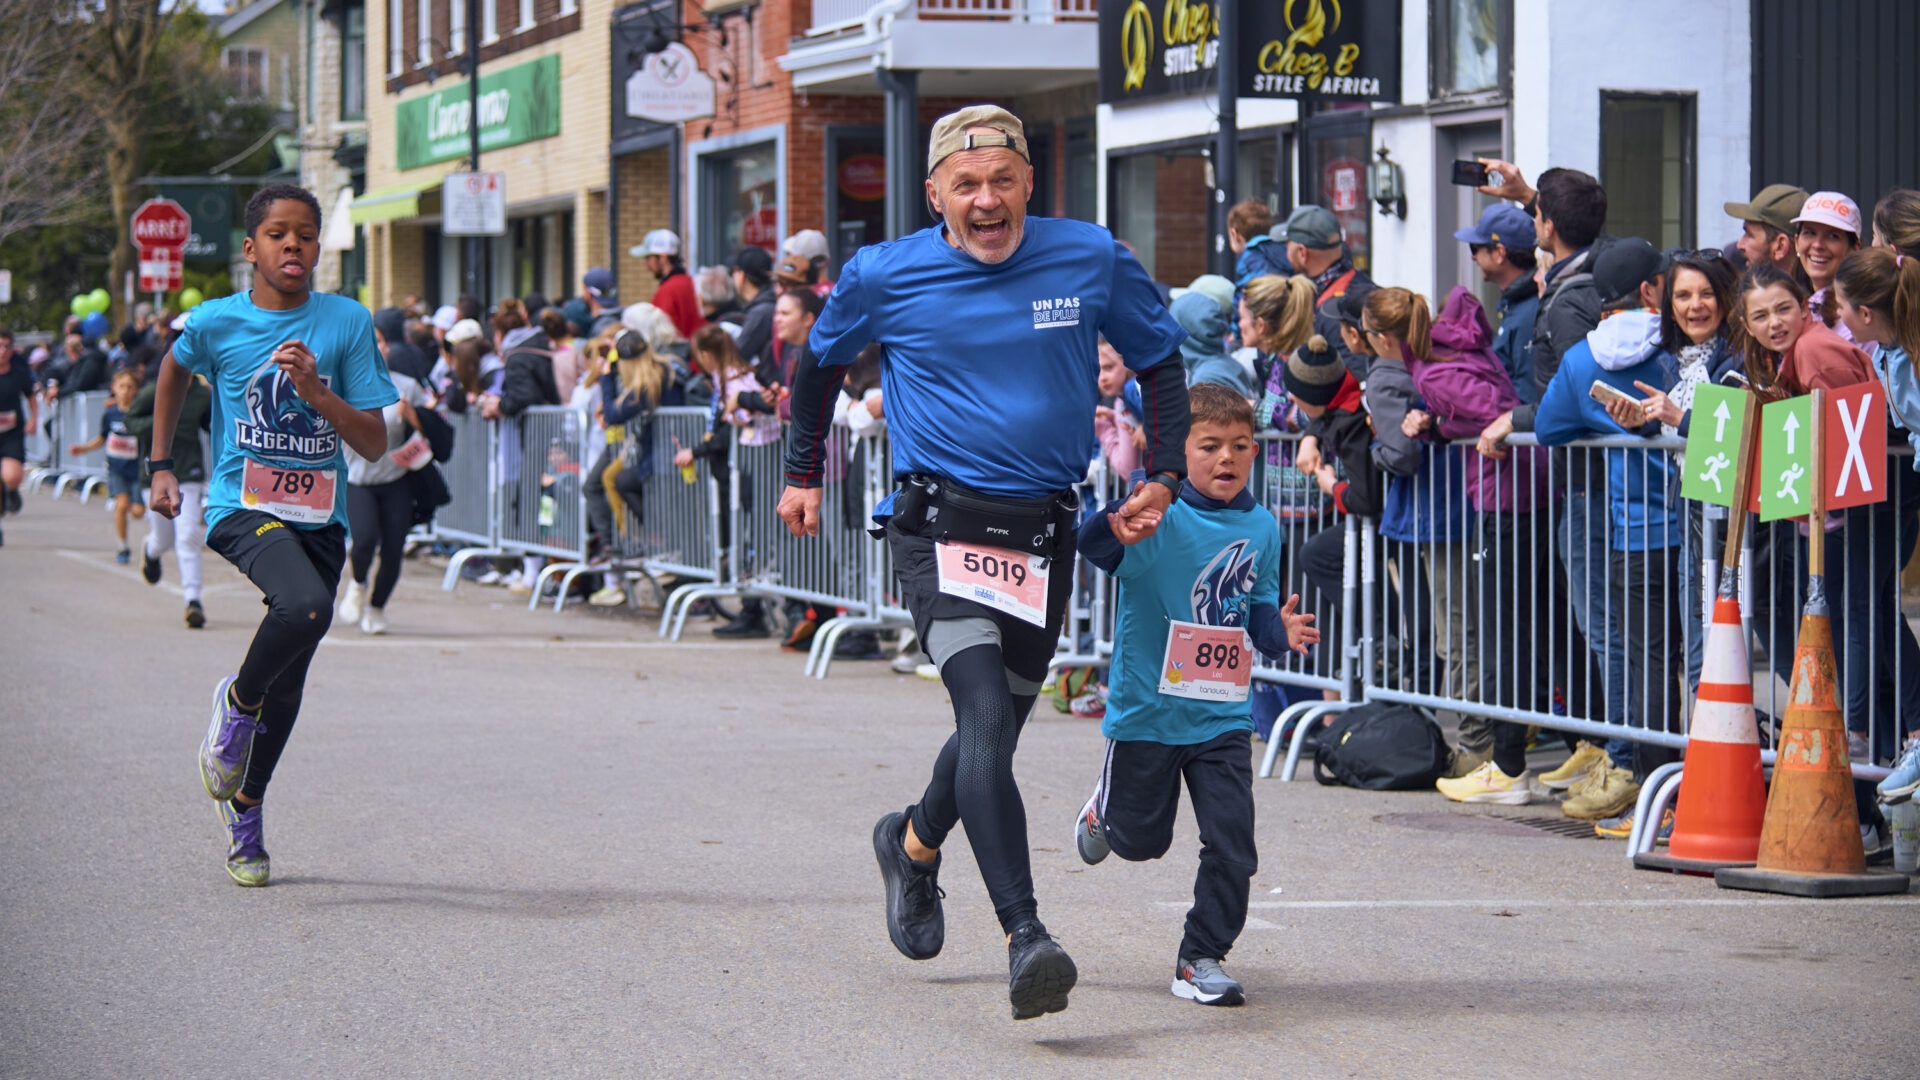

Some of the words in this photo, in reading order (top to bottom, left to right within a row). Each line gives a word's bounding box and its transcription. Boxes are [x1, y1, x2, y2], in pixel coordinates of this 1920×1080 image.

[1164, 44, 1199, 76] STYLE
[1258, 37, 1329, 90] Chez
[1334, 43, 1359, 76] B
[1253, 74, 1305, 93] STYLE
[1321, 76, 1380, 95] AFRICA
[1806, 196, 1850, 217] ciele
[137, 217, 186, 239] ARRÊT
[1033, 299, 1053, 311] UN
[1055, 297, 1080, 309] PAS
[1034, 310, 1051, 323] DE
[1052, 308, 1081, 321] PLUS
[240, 424, 336, 454] LÉGENDES
[271, 470, 315, 495] 789
[986, 526, 1010, 535] PYPK
[963, 551, 1027, 587] 5019
[1195, 643, 1240, 670] 898
